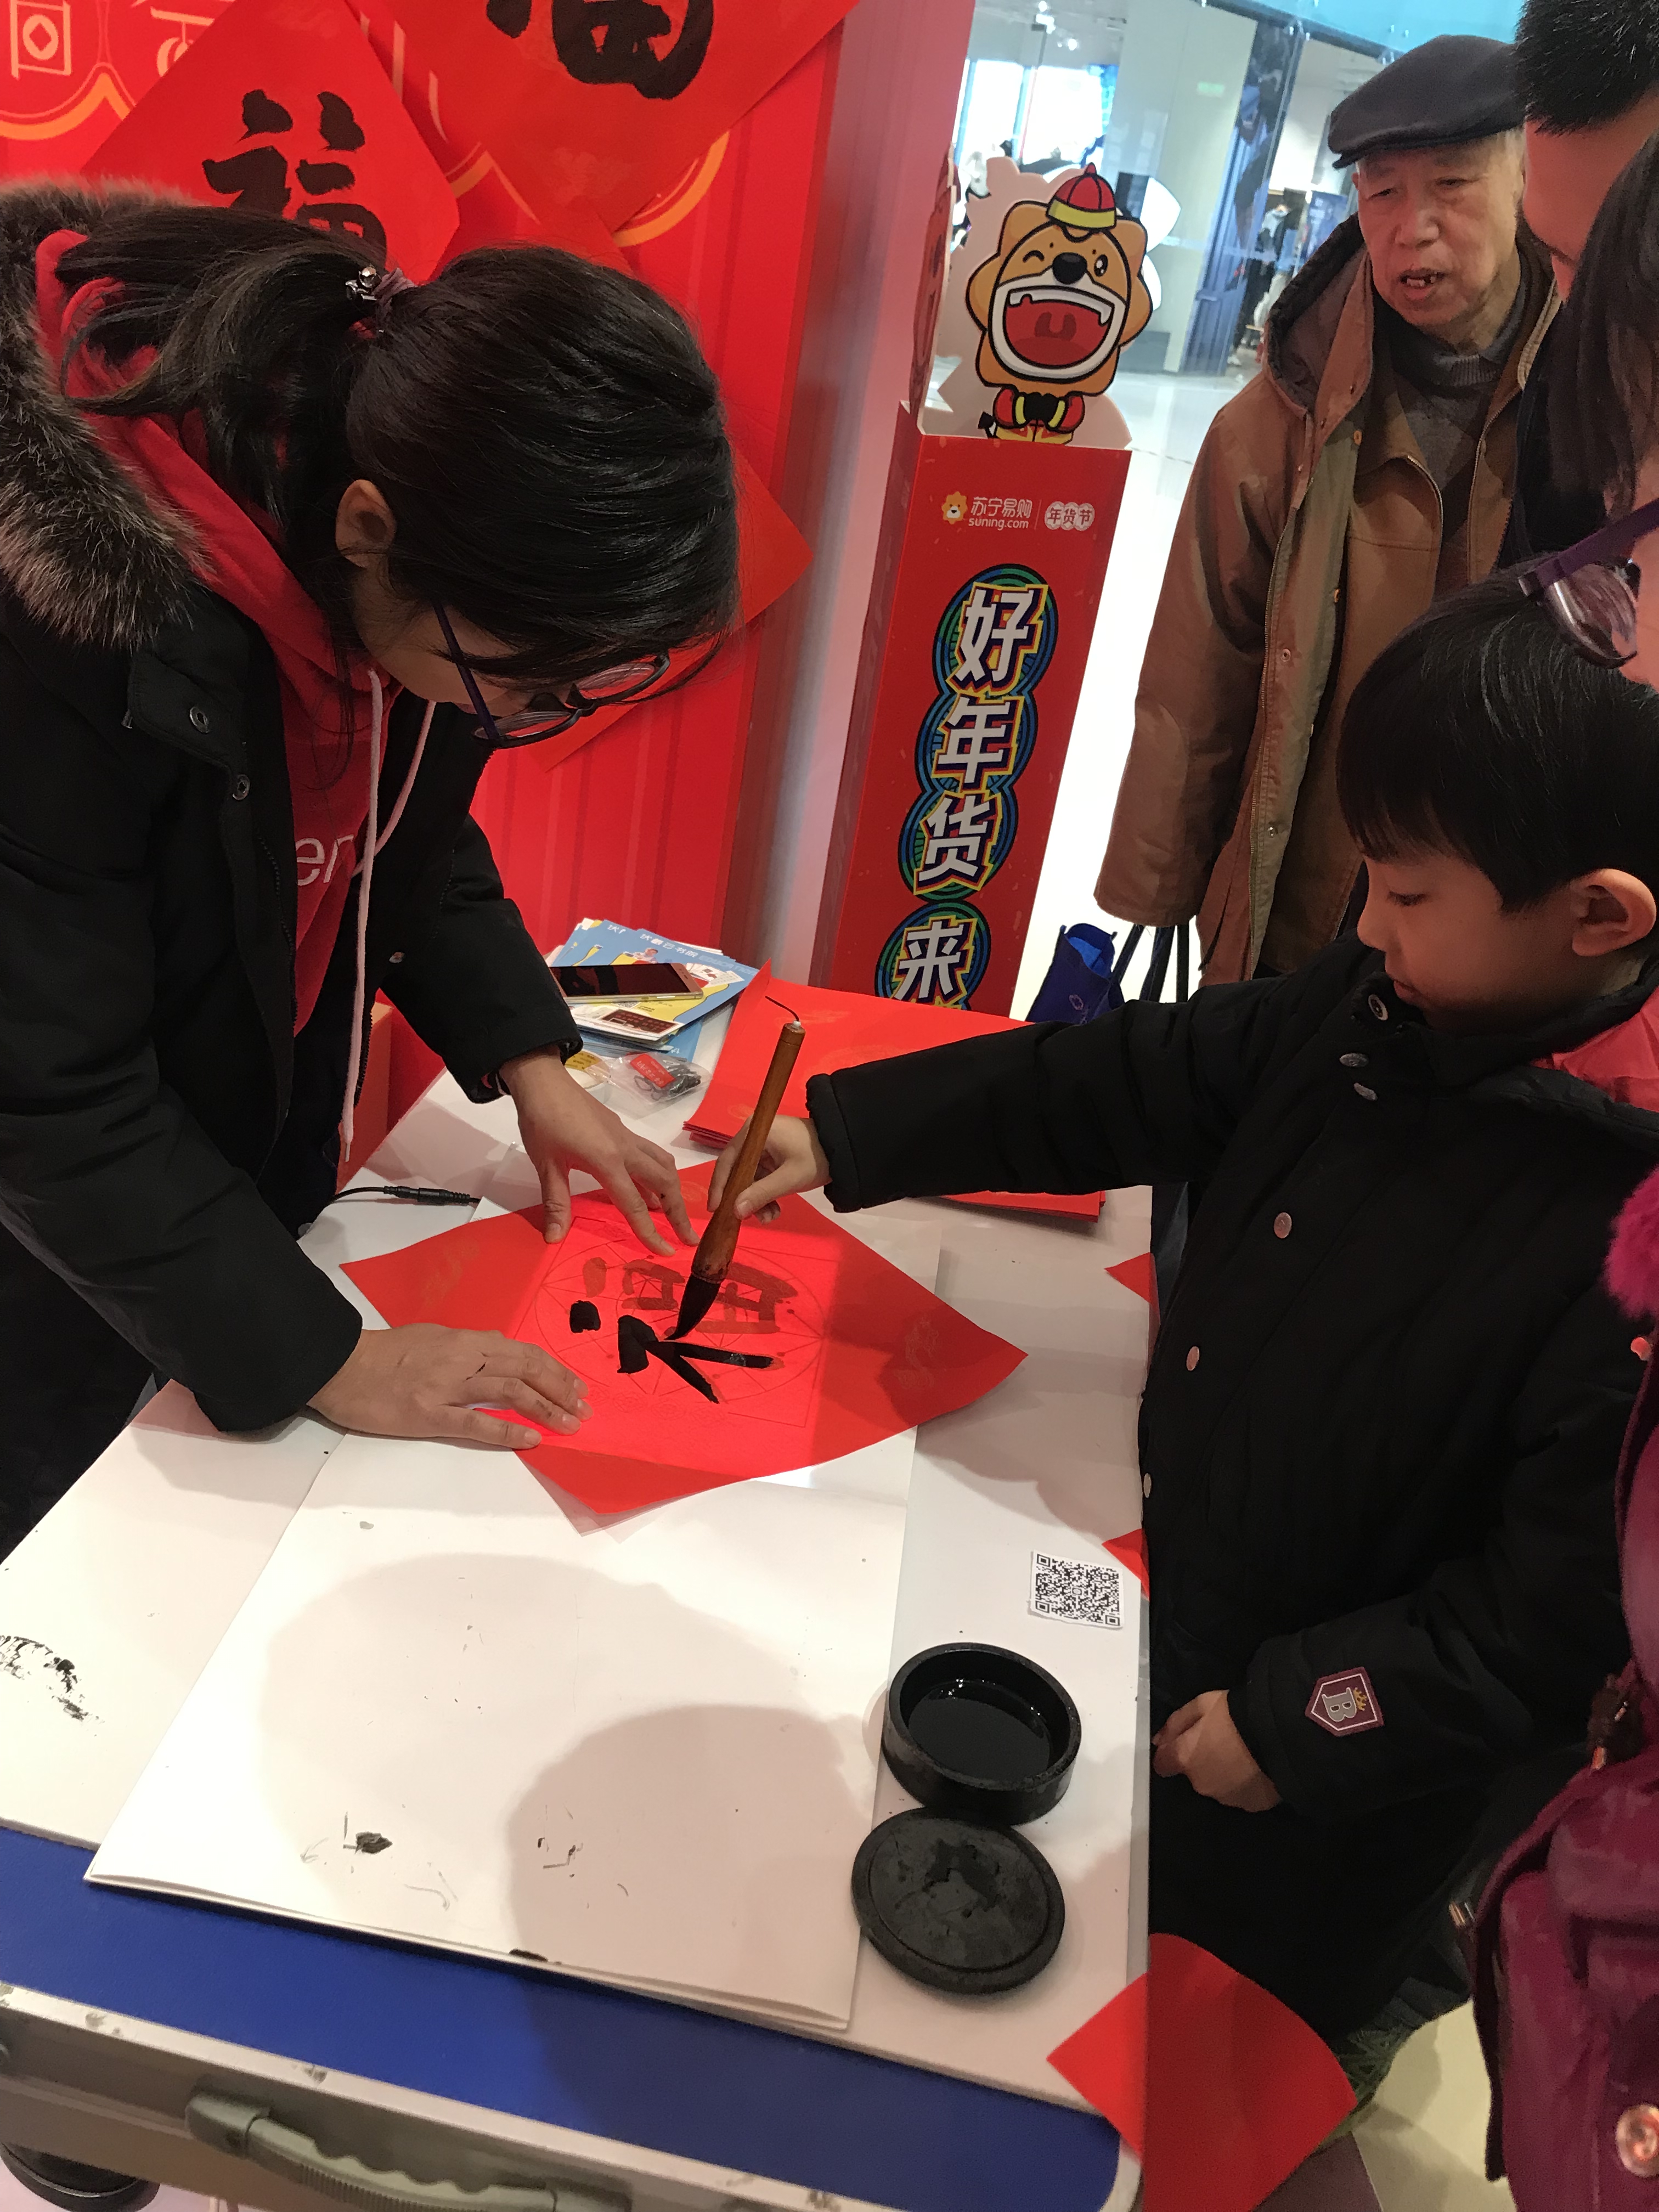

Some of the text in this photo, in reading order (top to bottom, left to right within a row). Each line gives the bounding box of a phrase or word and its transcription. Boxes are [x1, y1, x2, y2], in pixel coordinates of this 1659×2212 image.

[968, 517, 1029, 531] suning.com
[970, 496, 1093, 525] 苏宁易购 年货节
[1322, 1687, 1357, 1722] B
